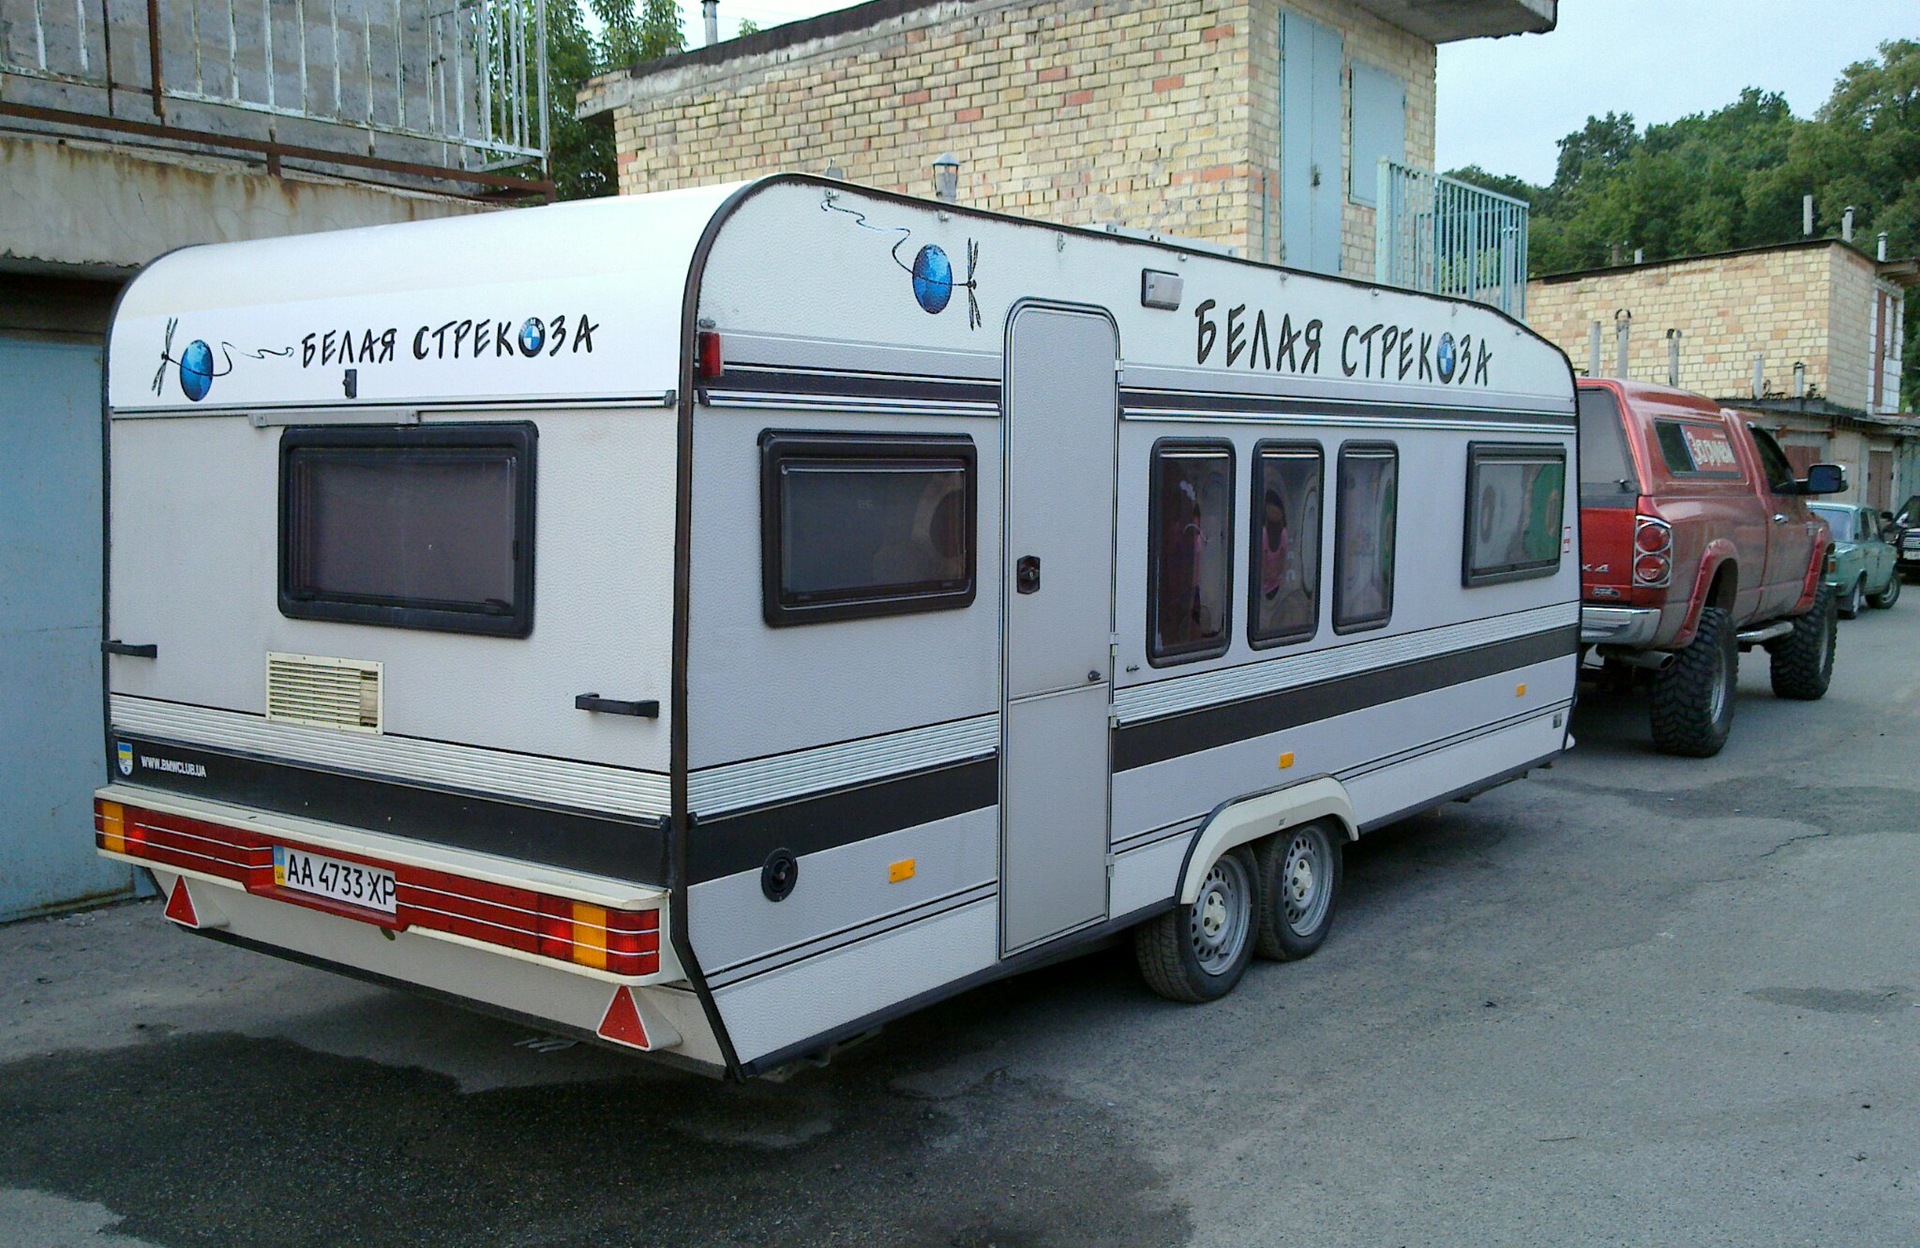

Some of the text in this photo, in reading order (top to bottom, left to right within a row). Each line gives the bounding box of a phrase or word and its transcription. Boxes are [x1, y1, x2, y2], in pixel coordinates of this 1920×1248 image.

[301, 328, 397, 368] БЕЛАЯ
[1194, 299, 1323, 374] БЕЛАЯ
[140, 755, 207, 778] WWW.BMWCLUB.UA
[287, 853, 397, 906] AA 4733 XP
